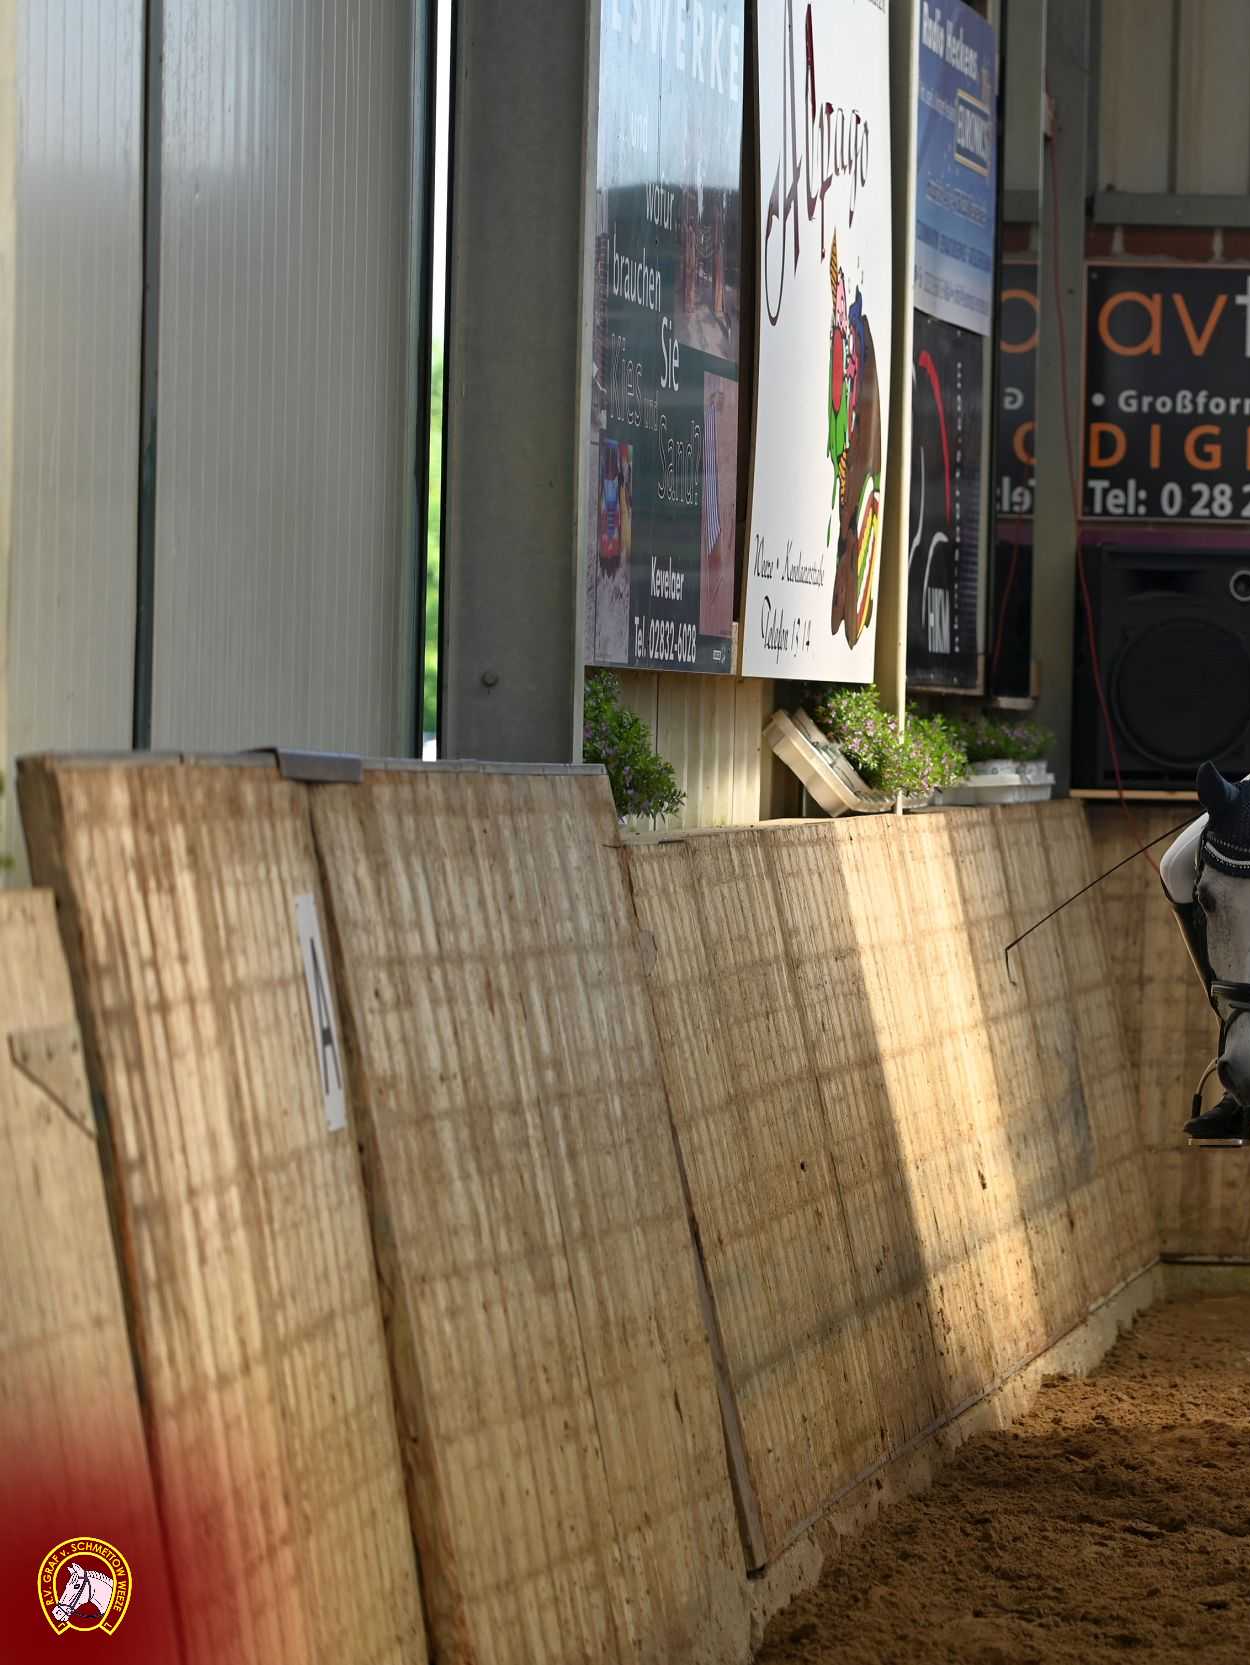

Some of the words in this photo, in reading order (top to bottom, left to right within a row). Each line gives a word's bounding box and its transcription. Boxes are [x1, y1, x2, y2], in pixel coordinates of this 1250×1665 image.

[613, 232, 661, 313] brauchen
[661, 316, 680, 392] Sie
[1088, 478, 1147, 515] Tel:
[650, 556, 685, 601] Kevelaer
[634, 616, 646, 658] Tel.
[649, 619, 697, 664] 02832-6028
